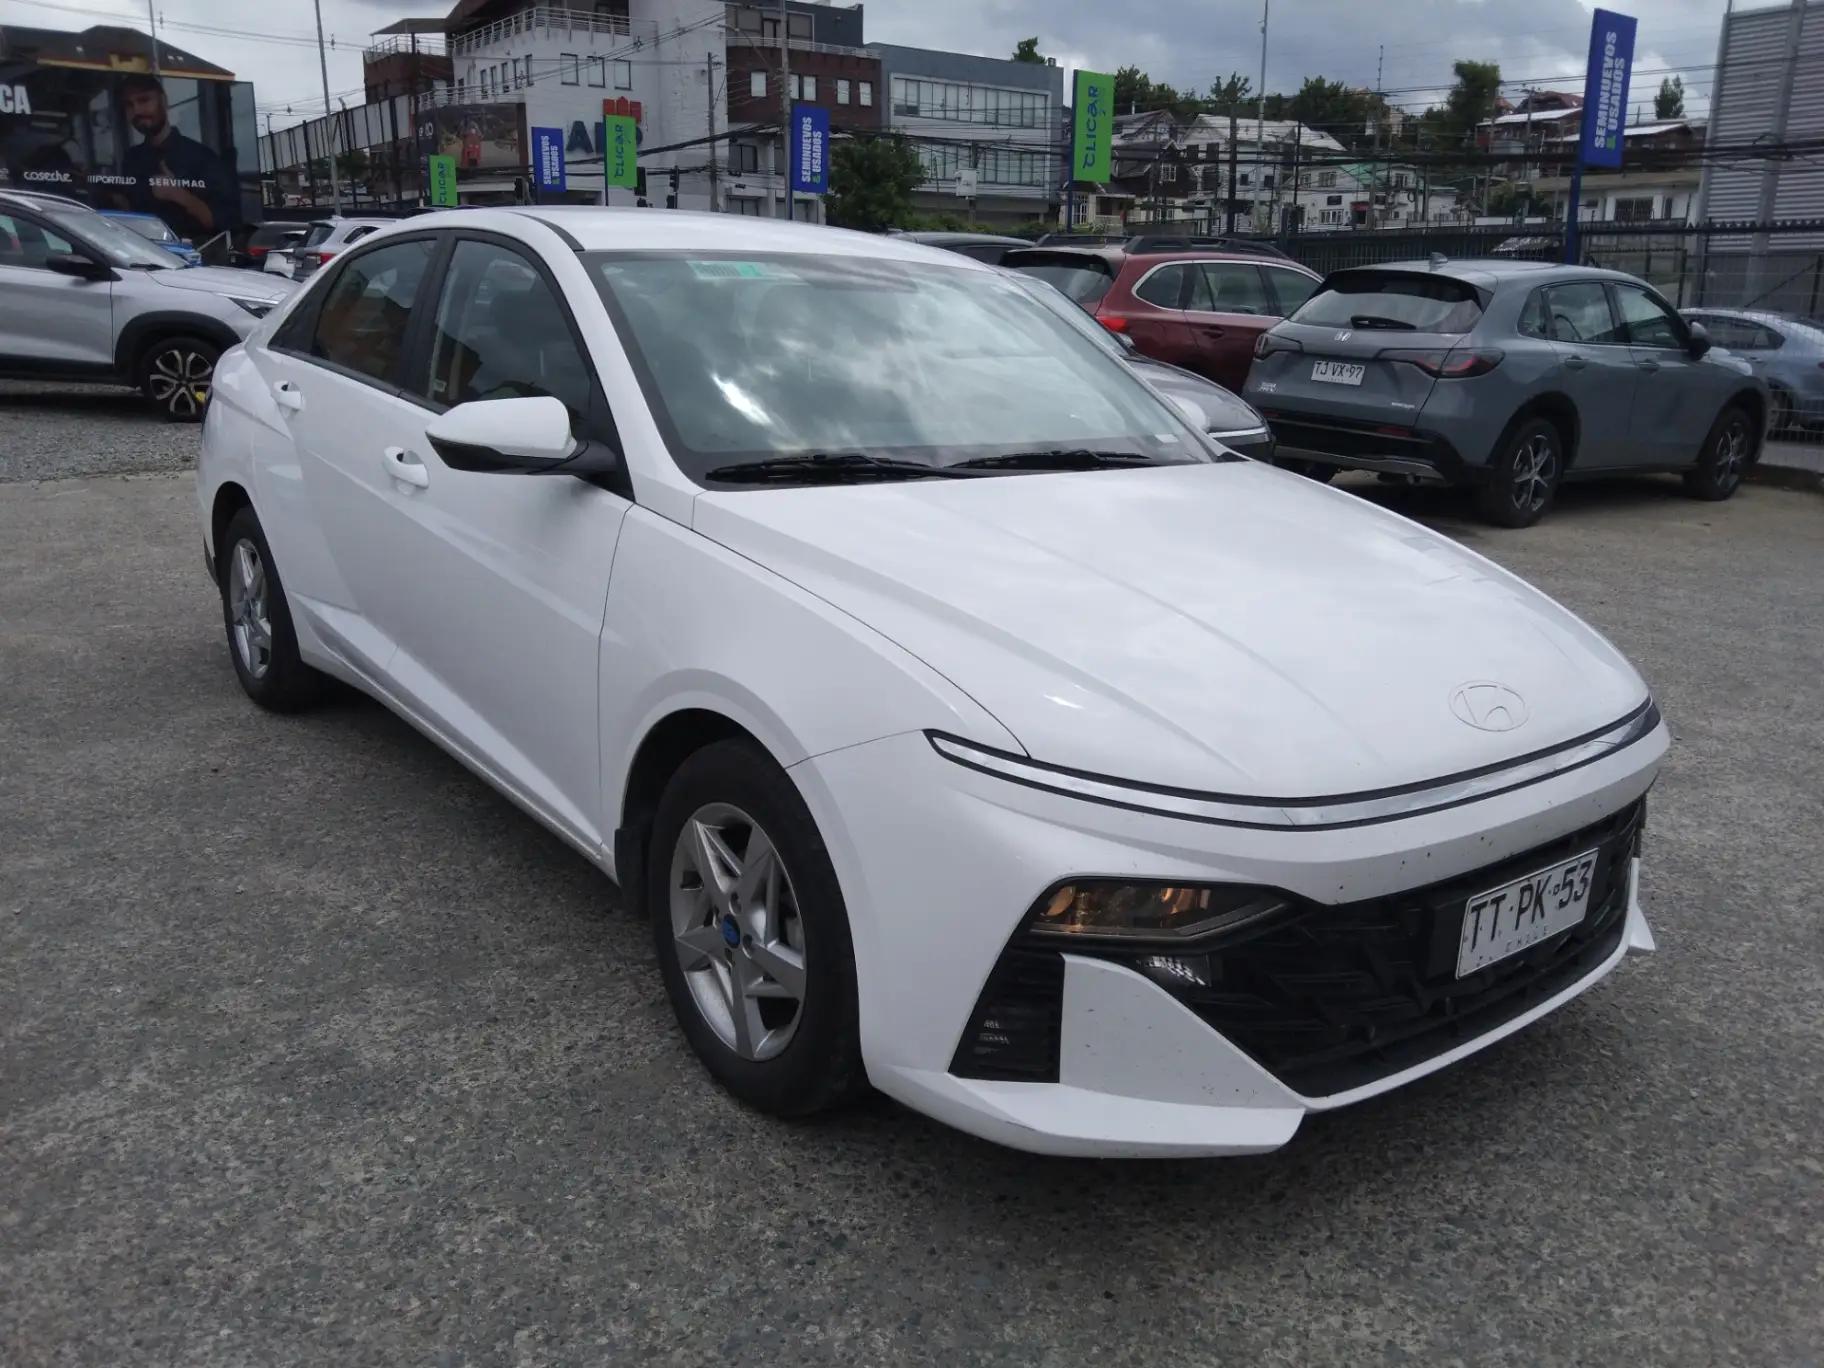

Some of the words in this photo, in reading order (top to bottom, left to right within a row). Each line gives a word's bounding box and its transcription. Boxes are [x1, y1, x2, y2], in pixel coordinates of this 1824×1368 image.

[1594, 31, 1617, 149] SEMINUEVOS
[1608, 58, 1625, 131] USADOS
[541, 135, 552, 185] SEMINUEVOS
[550, 145, 560, 178] USADOS
[802, 116, 812, 182] SEMINUEVOS
[812, 130, 822, 173] USADOS
[148, 177, 206, 189] SERVIMAQ
